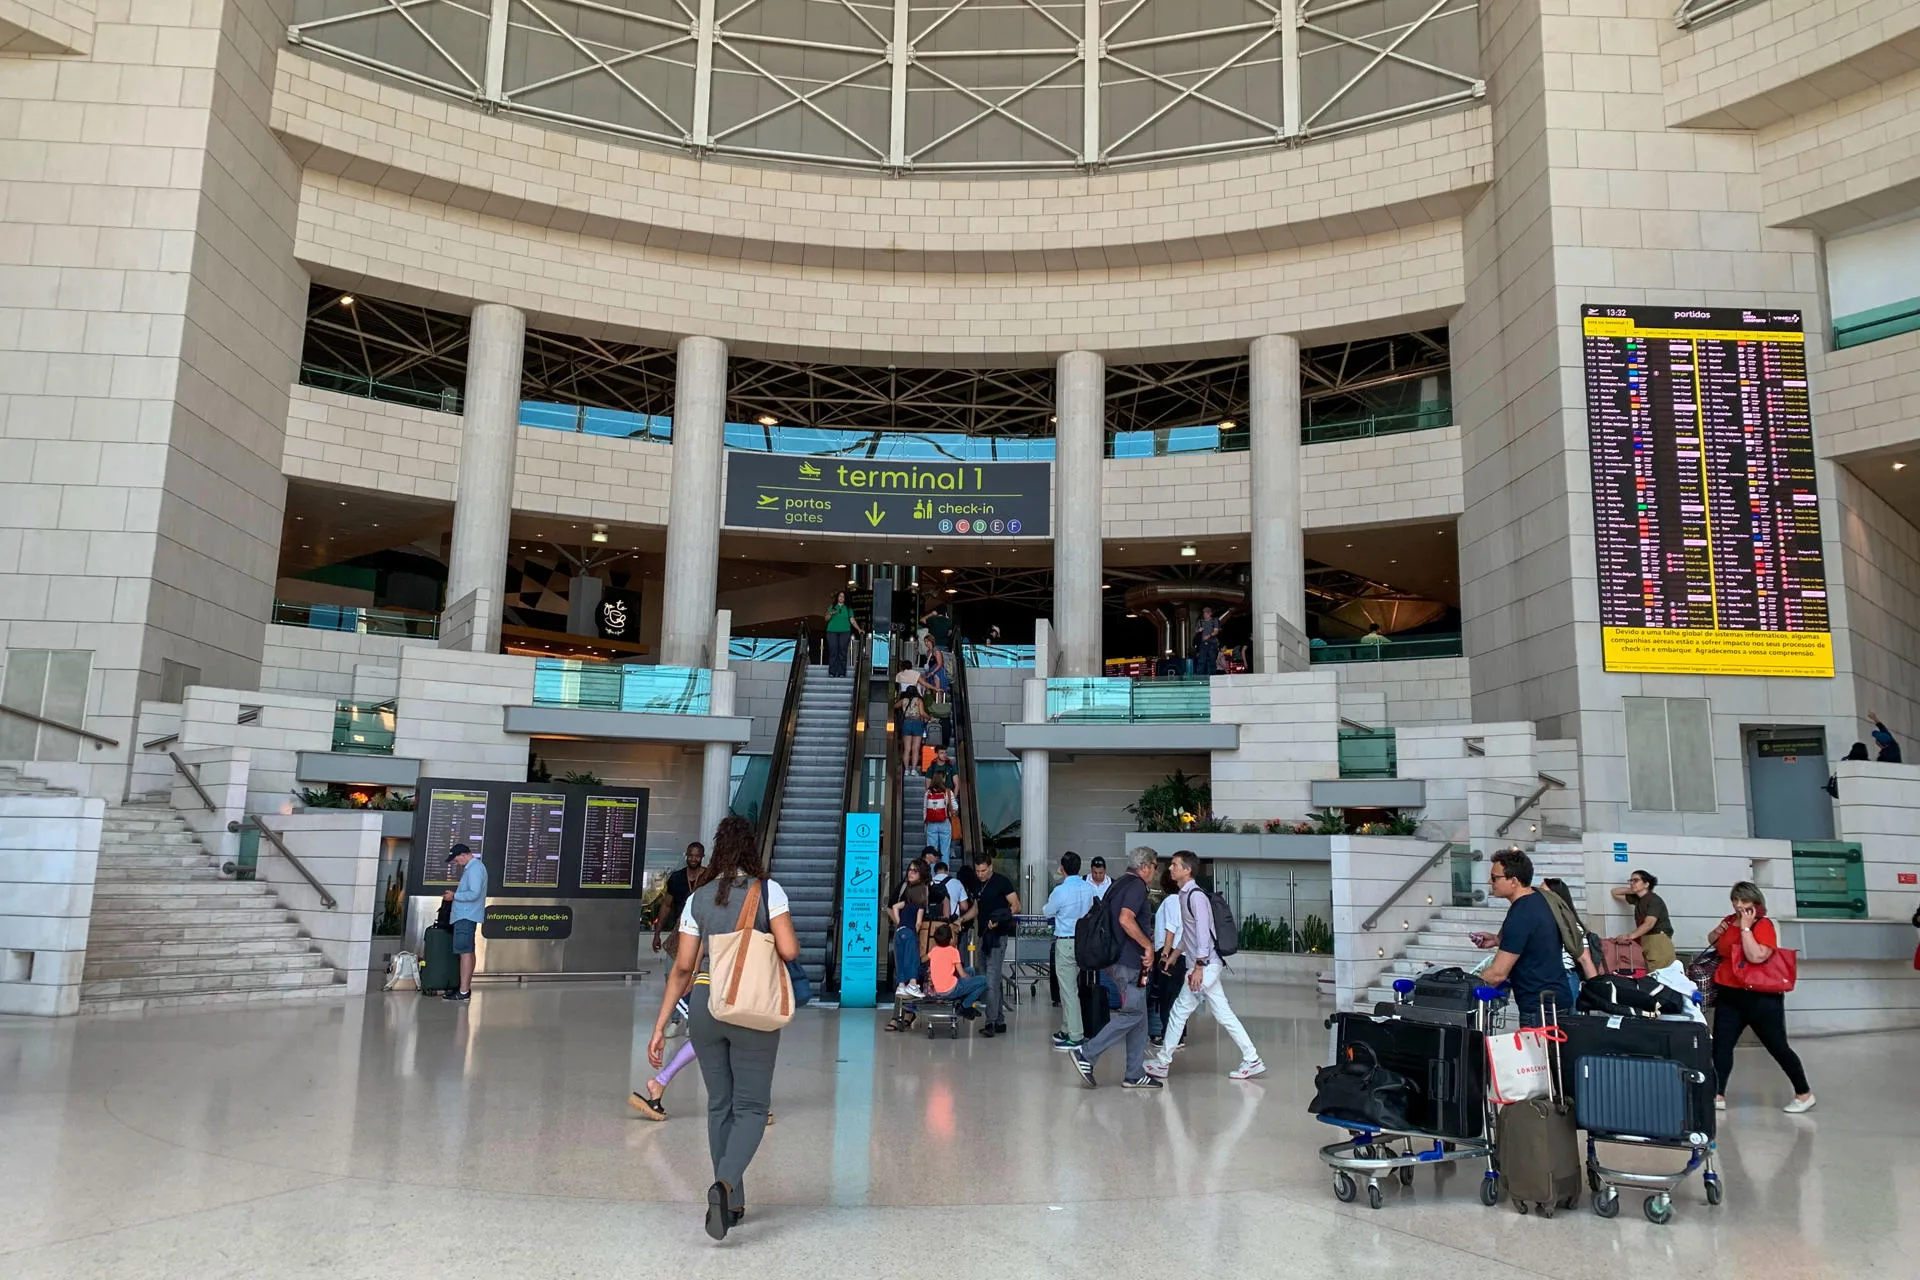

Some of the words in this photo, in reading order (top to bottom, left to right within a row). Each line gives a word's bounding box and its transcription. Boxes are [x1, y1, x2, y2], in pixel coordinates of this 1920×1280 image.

[1606, 309, 1626, 317] 13:32
[1674, 310, 1711, 319] partidas
[837, 465, 963, 490] terminal
[974, 467, 982, 490] 1
[785, 498, 831, 510] portas
[938, 503, 994, 514] check-in
[784, 512, 824, 524] gates
